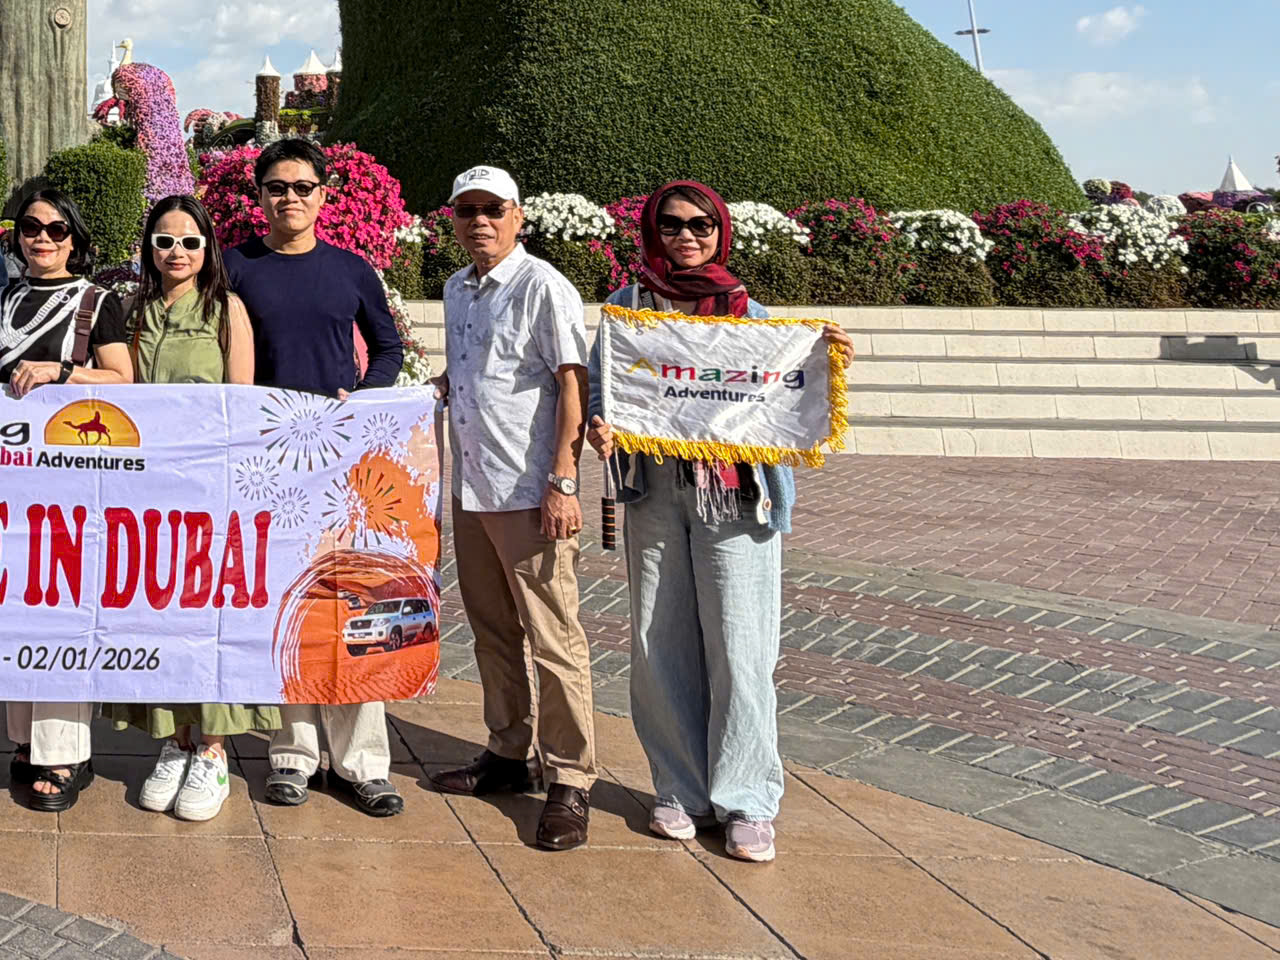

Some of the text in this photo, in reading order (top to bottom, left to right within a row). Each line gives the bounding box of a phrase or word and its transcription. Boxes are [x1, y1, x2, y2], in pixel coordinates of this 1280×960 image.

[624, 356, 806, 390] Amazing
[663, 385, 767, 404] Adventures
[35, 451, 146, 472] Adventures
[23, 502, 87, 608] IN
[99, 506, 272, 611] DUBAI
[17, 645, 161, 671] 02/01/2026
